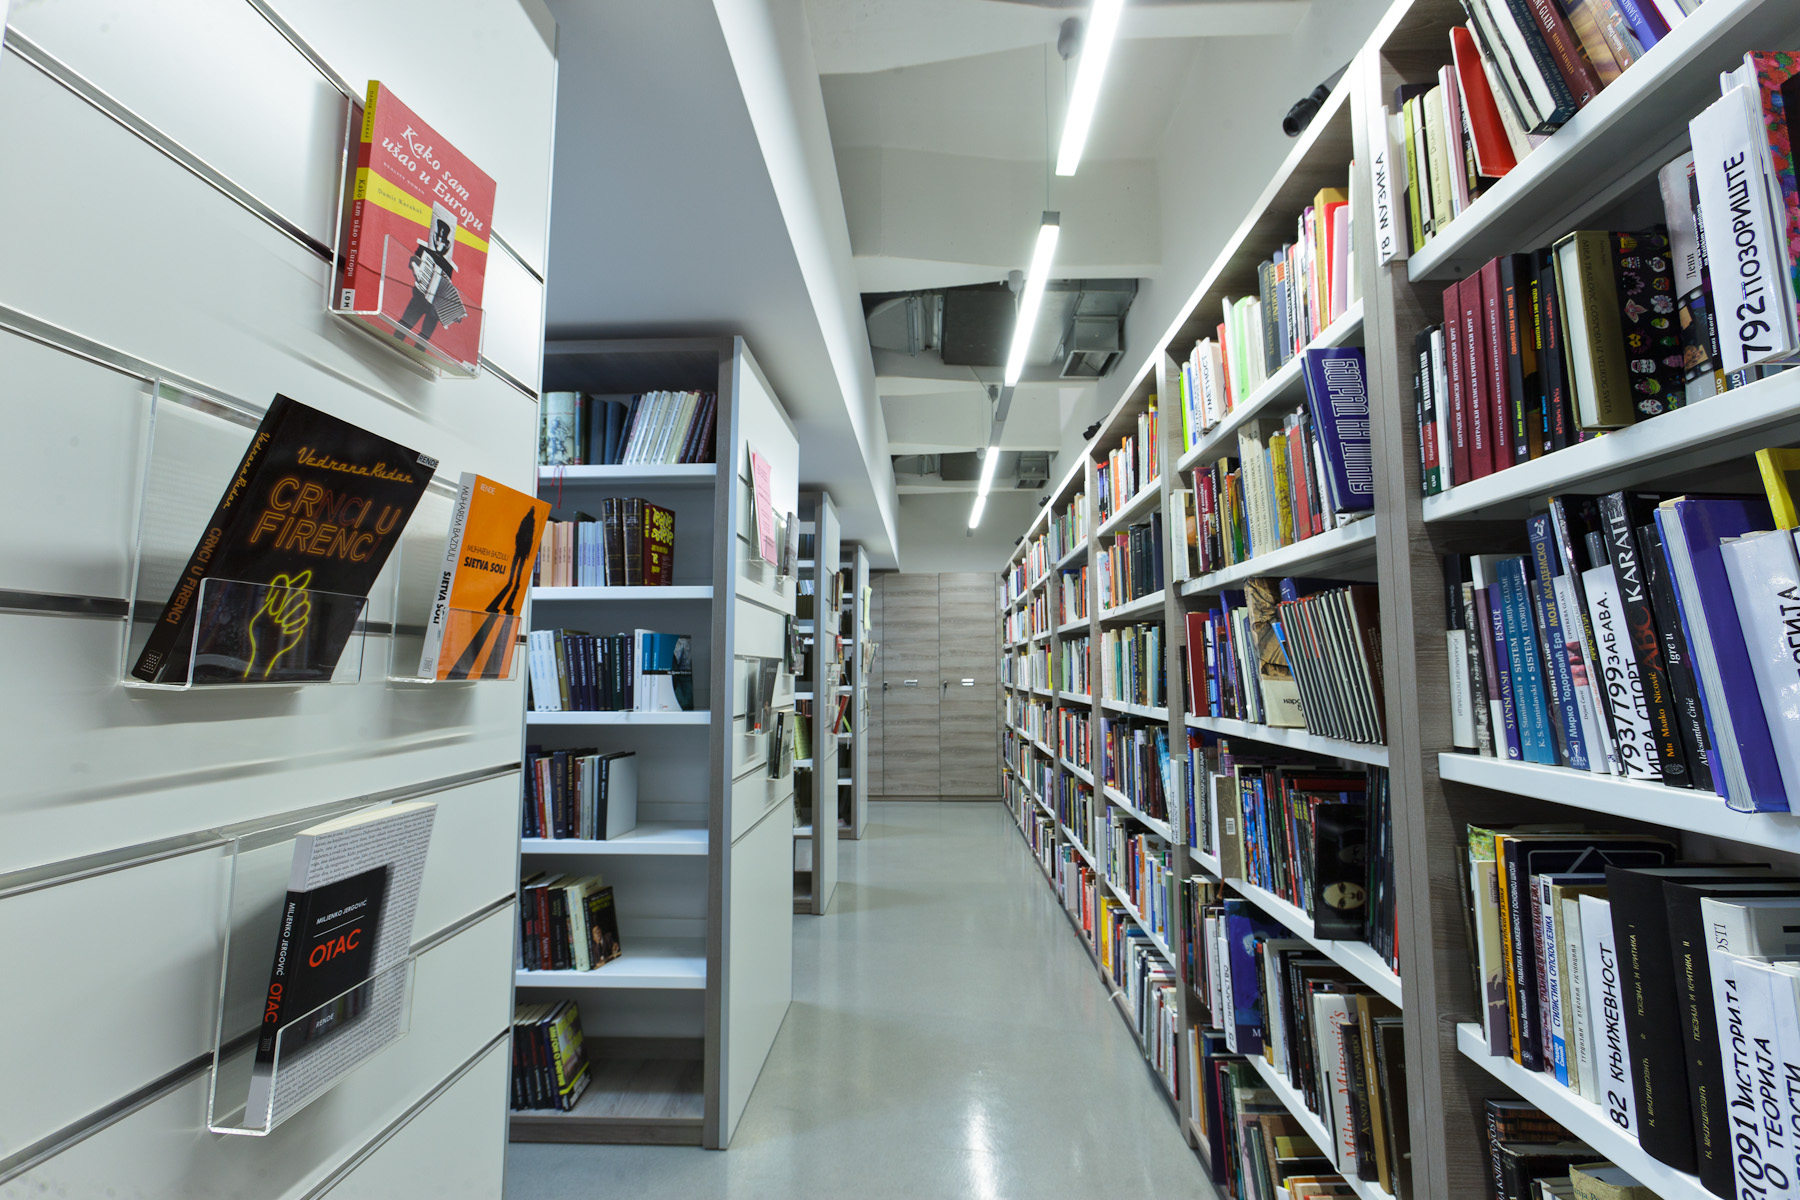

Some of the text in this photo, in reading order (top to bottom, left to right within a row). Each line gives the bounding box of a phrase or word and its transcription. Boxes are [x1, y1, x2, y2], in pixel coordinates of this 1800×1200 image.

[1539, 5, 1556, 33] GLAZBE
[1552, 32, 1564, 53] ROBERT
[400, 125, 470, 201] Kako sam
[357, 179, 366, 198] Kako
[382, 137, 484, 231] ušao u Europu
[1375, 151, 1391, 262] 78 МУЗИКА
[352, 220, 360, 238] ušao
[346, 249, 358, 277] Europu
[1580, 238, 1590, 260] MIRA
[343, 291, 351, 309] LOM
[1419, 350, 1427, 367] FILMA
[1450, 341, 1459, 380] КРИТИЧАРСКИ
[1467, 333, 1477, 377] КРИТИЧАРСКИ
[1491, 324, 1500, 370] КРИТИЧАРСКИ
[1322, 358, 1370, 418] БЕОГРАД
[1597, 354, 1609, 388] VELIKOG
[1452, 382, 1461, 410] ФИЛМСКИ
[1470, 377, 1479, 408] ФИЛМСКИ
[1602, 389, 1613, 414] SVETA
[1455, 411, 1463, 447] БЕОГРАДСКИ
[1472, 409, 1482, 449] БЕОГРАДСКИ
[1497, 405, 1505, 445] БЕОГРАДСКИ
[298, 447, 414, 483] Vedrana Rudan
[418, 454, 439, 468] RENDE
[270, 477, 401, 535] CRNCI U
[454, 485, 470, 526] MUHAREM
[480, 483, 495, 495] RENDE
[166, 432, 270, 625] Vedrana Rudan CRNCI U FIRENCI
[251, 510, 383, 563] FIRENCI
[464, 557, 506, 575] SJETVA SOLI
[467, 544, 491, 559] MUHAREM
[1607, 504, 1644, 603] KARATE
[438, 571, 452, 601] SJETVA
[1500, 575, 1511, 603] GLUME
[1513, 574, 1523, 601] GLUME
[433, 603, 444, 625] SOLI
[1492, 607, 1504, 641] BESEDE
[1505, 603, 1515, 634] TEORIJA
[1518, 602, 1528, 632] TEORIJA
[1558, 590, 1573, 639] UPOTREBA GLASA
[1510, 636, 1521, 673] SISTEM
[1523, 635, 1535, 673] SISTEM
[1534, 541, 1580, 738] Мирко Тодоровић Ера МОЈЕ АКАДЕМСКО
[1629, 605, 1662, 672] ABC
[1666, 632, 1680, 665] Igre u
[1516, 684, 1529, 728] Stanislavski
[1530, 683, 1542, 728] Stanislavski
[1581, 704, 1589, 720] Dejan
[1626, 660, 1662, 780] ИГРА СПОРТ
[1691, 719, 1708, 766] Aleksandar
[1508, 860, 1516, 880] ШКОЛИ
[316, 898, 368, 925] MILJENKO JERGOVIĆ
[1509, 880, 1519, 909] ОСНОВНОЈ
[1512, 913, 1522, 949] КЊИЖЕВНОСТ
[1544, 915, 1554, 942] ЈЕЗИКА
[264, 901, 296, 1024] MILJENKO JERGOVIĆ OTAC
[308, 928, 362, 968] OTAC
[1628, 933, 1639, 970] КРИТИКА
[1515, 955, 1524, 985] ГРАМАТИКА
[1684, 952, 1694, 991] КРИТИКА
[1223, 964, 1233, 1027] СЛИКАРСТВО
[1518, 988, 1527, 1019] Милошевић
[1549, 978, 1560, 1027] СТИЛИСТИКА
[1633, 980, 1645, 1016] ПОЕЗИЈА
[316, 1013, 335, 1029] RENDE
[1521, 1019, 1529, 1038] Милош
[1599, 943, 1629, 1131] 82 КЊИЖЕВНОСТ
[1689, 1003, 1700, 1041] ПОЕЗИЈА
[1754, 1038, 1789, 1190] О ТЕОРИЈА
